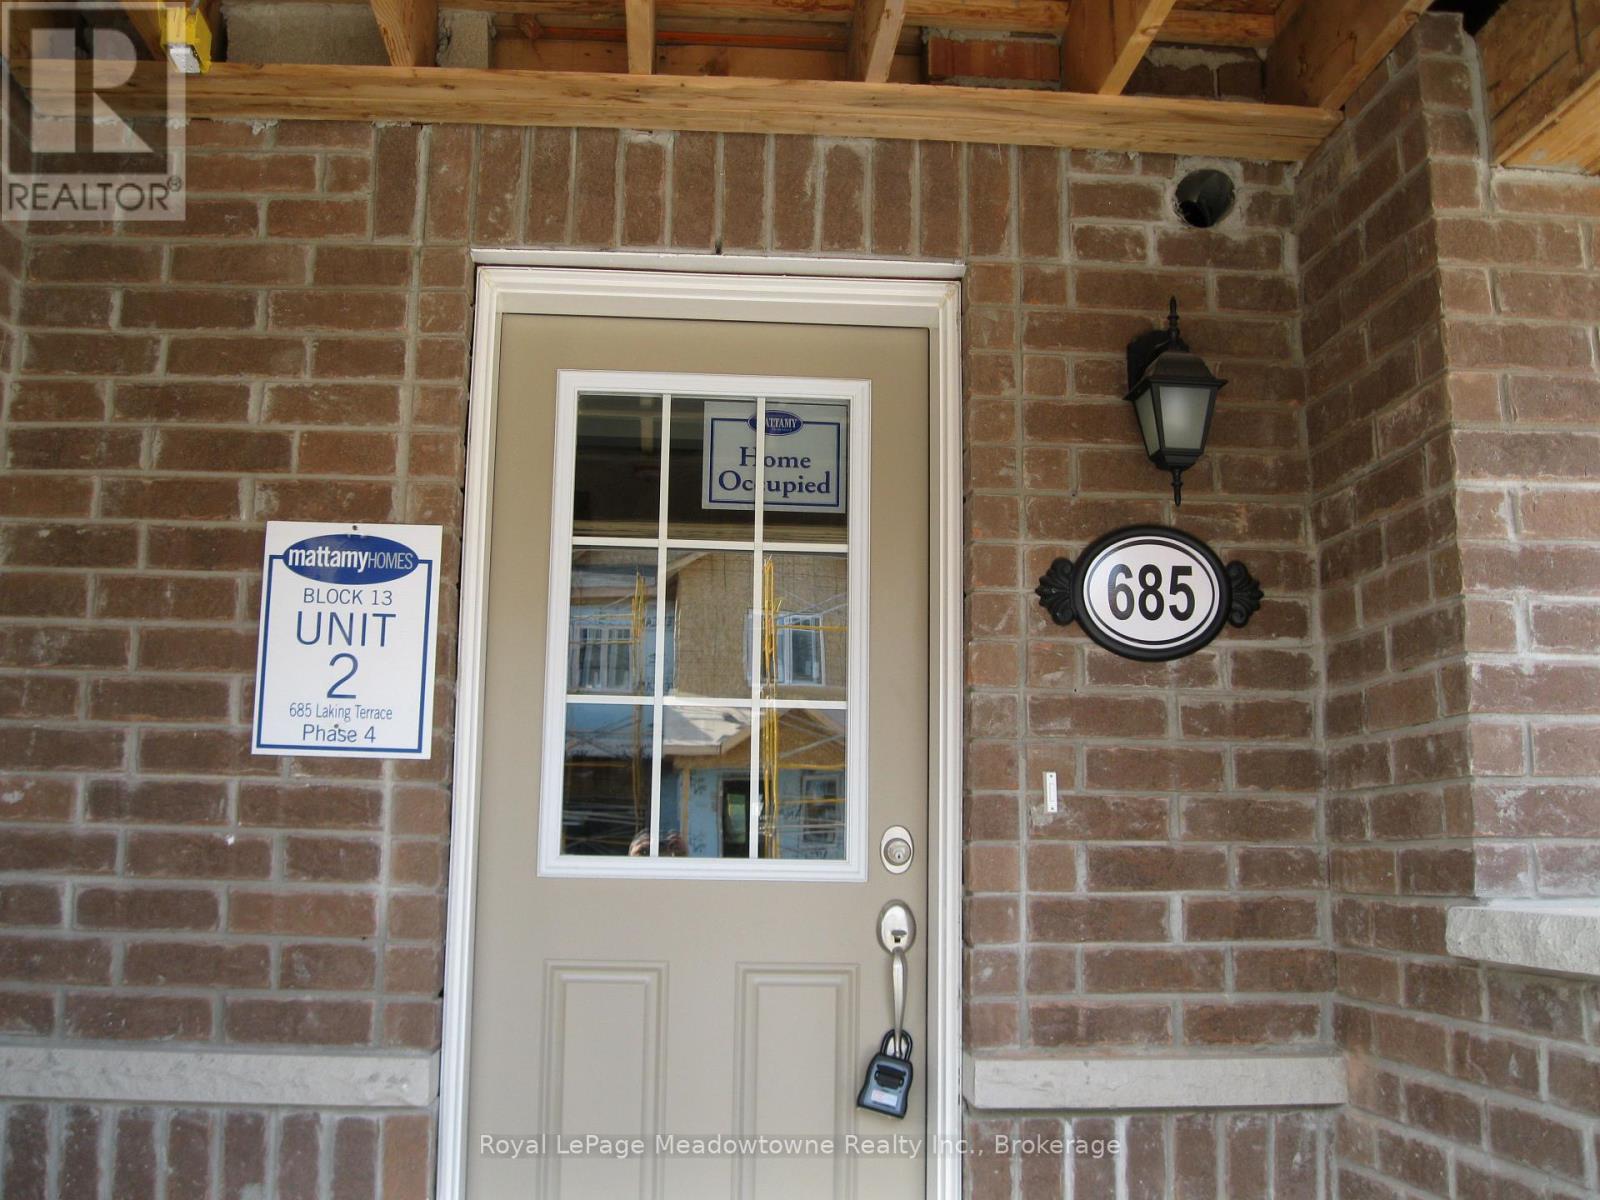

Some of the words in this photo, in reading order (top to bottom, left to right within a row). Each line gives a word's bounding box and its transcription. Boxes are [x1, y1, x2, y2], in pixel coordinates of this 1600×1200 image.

[763, 416, 798, 428] ATTAMY
[739, 446, 812, 469] Home
[718, 470, 831, 498] Ocupied
[303, 587, 364, 605] BLOCK
[371, 589, 393, 606] 13
[1107, 563, 1196, 621] 685
[296, 610, 397, 647] UNIT
[326, 652, 359, 699] 2
[289, 702, 312, 718] 685
[315, 703, 351, 722] Laking
[355, 704, 393, 720] Terrace
[302, 723, 357, 743] Phase
[363, 726, 377, 743] 4
